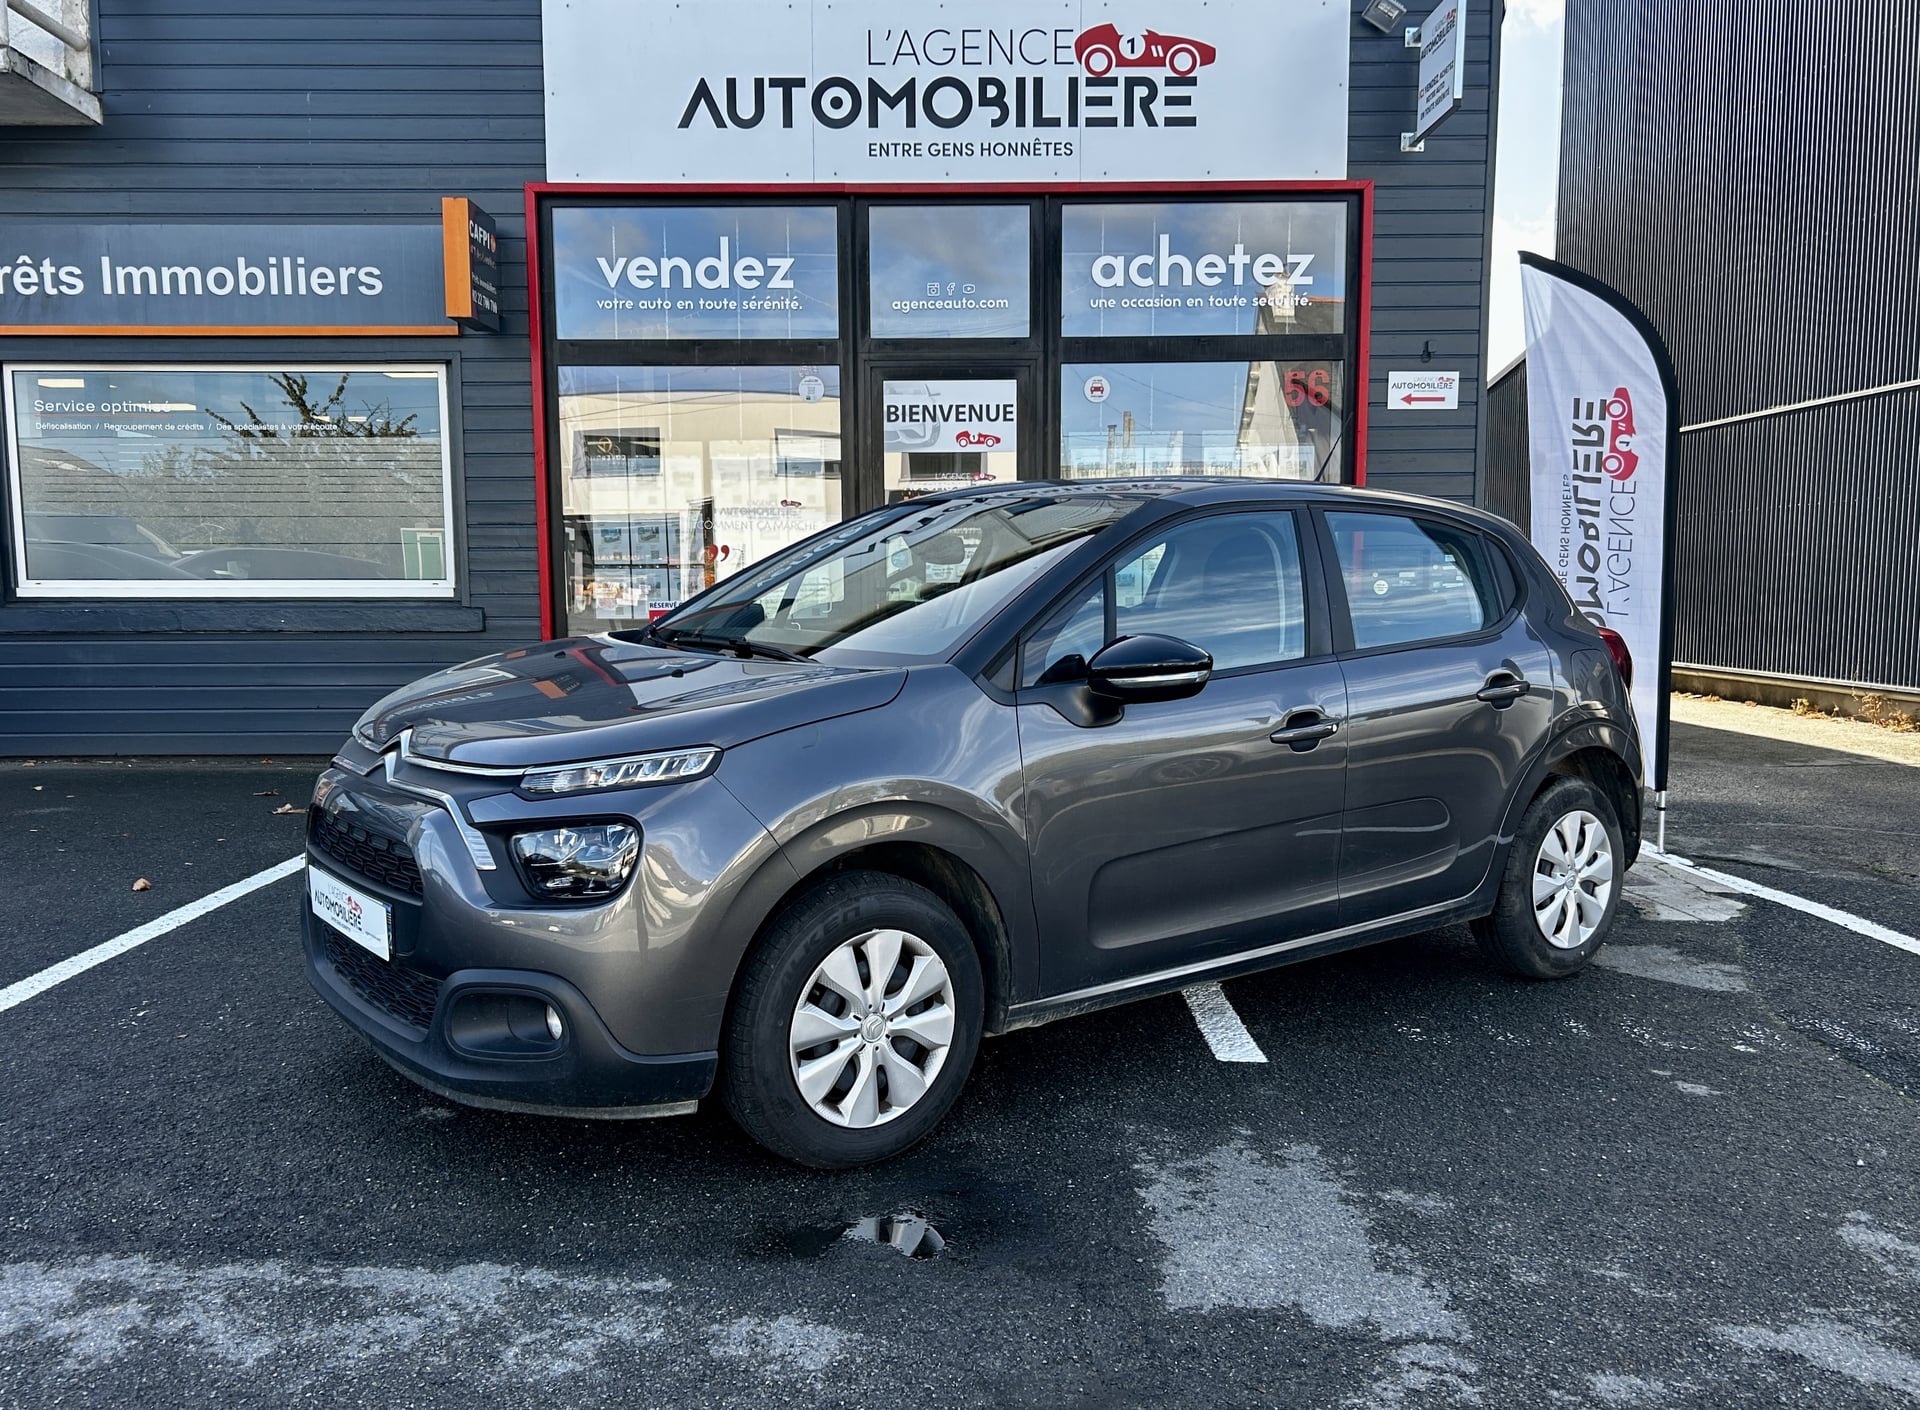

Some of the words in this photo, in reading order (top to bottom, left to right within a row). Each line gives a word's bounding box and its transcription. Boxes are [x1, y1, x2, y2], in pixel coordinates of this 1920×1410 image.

[867, 28, 1074, 66] L'AGENCE
[1126, 37, 1135, 54] 1
[678, 76, 1197, 129] AUTOMOBILIERE
[868, 142, 923, 157] ENTRE
[928, 142, 974, 157] GENS
[980, 137, 1074, 157] HONNÊTES
[469, 219, 490, 250] CAFPI
[596, 236, 796, 290] vendez
[1091, 234, 1315, 287] achetez
[0, 255, 84, 295] rêts
[101, 256, 383, 295] Immobiliers
[596, 298, 634, 310] votre
[638, 298, 672, 310] auto
[676, 300, 694, 310] en
[699, 298, 737, 310] toute
[742, 296, 803, 310] sérénité.
[892, 296, 1009, 314] agenceauto.com
[1090, 298, 1116, 308] une
[1121, 294, 1182, 308] occasion
[1186, 297, 1204, 307] en
[1208, 295, 1247, 307] toute
[1284, 369, 1330, 407] 56
[34, 400, 96, 412] Service
[886, 404, 1015, 423] BIENVENUE
[35, 422, 92, 431] Défiscalisation
[104, 422, 163, 433] Regroupement
[165, 422, 175, 431] de
[177, 422, 204, 431] crédits
